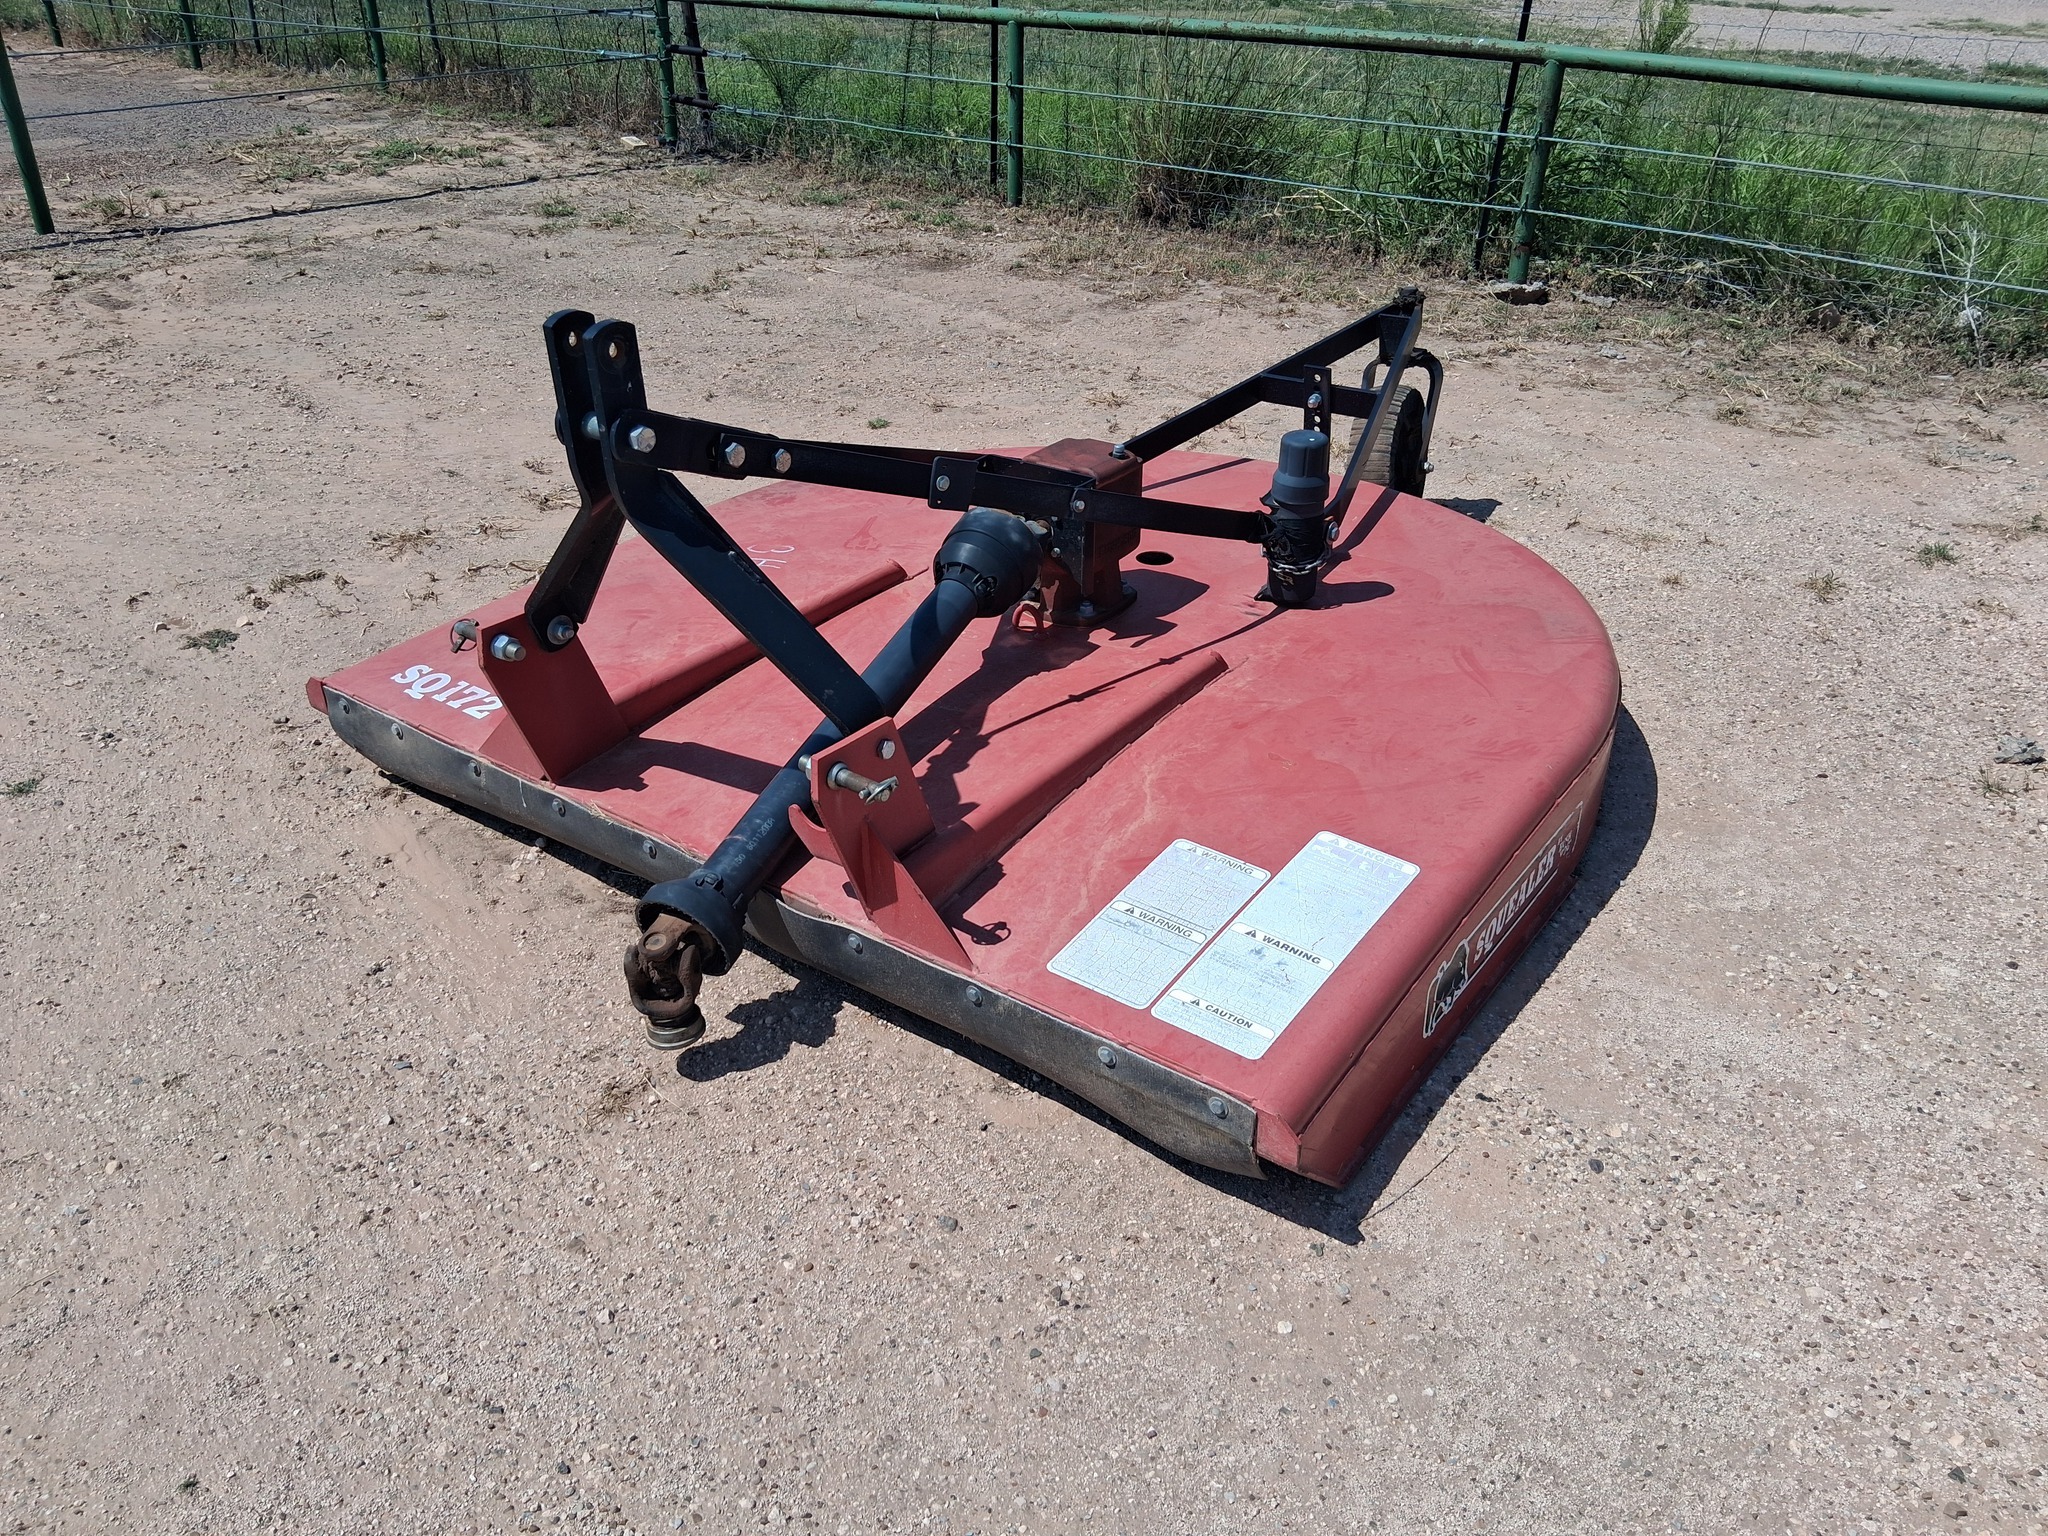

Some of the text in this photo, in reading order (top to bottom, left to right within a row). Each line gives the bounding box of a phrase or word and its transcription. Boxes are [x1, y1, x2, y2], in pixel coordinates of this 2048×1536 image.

[390, 664, 503, 719] SQ172
[1201, 850, 1254, 876] WARNING
[1344, 843, 1406, 871] DANGER
[1473, 844, 1557, 964] SQUEALER
[1138, 910, 1193, 938] WARNING
[1262, 934, 1322, 965] WARNING
[1205, 1004, 1254, 1029] CAUTION
